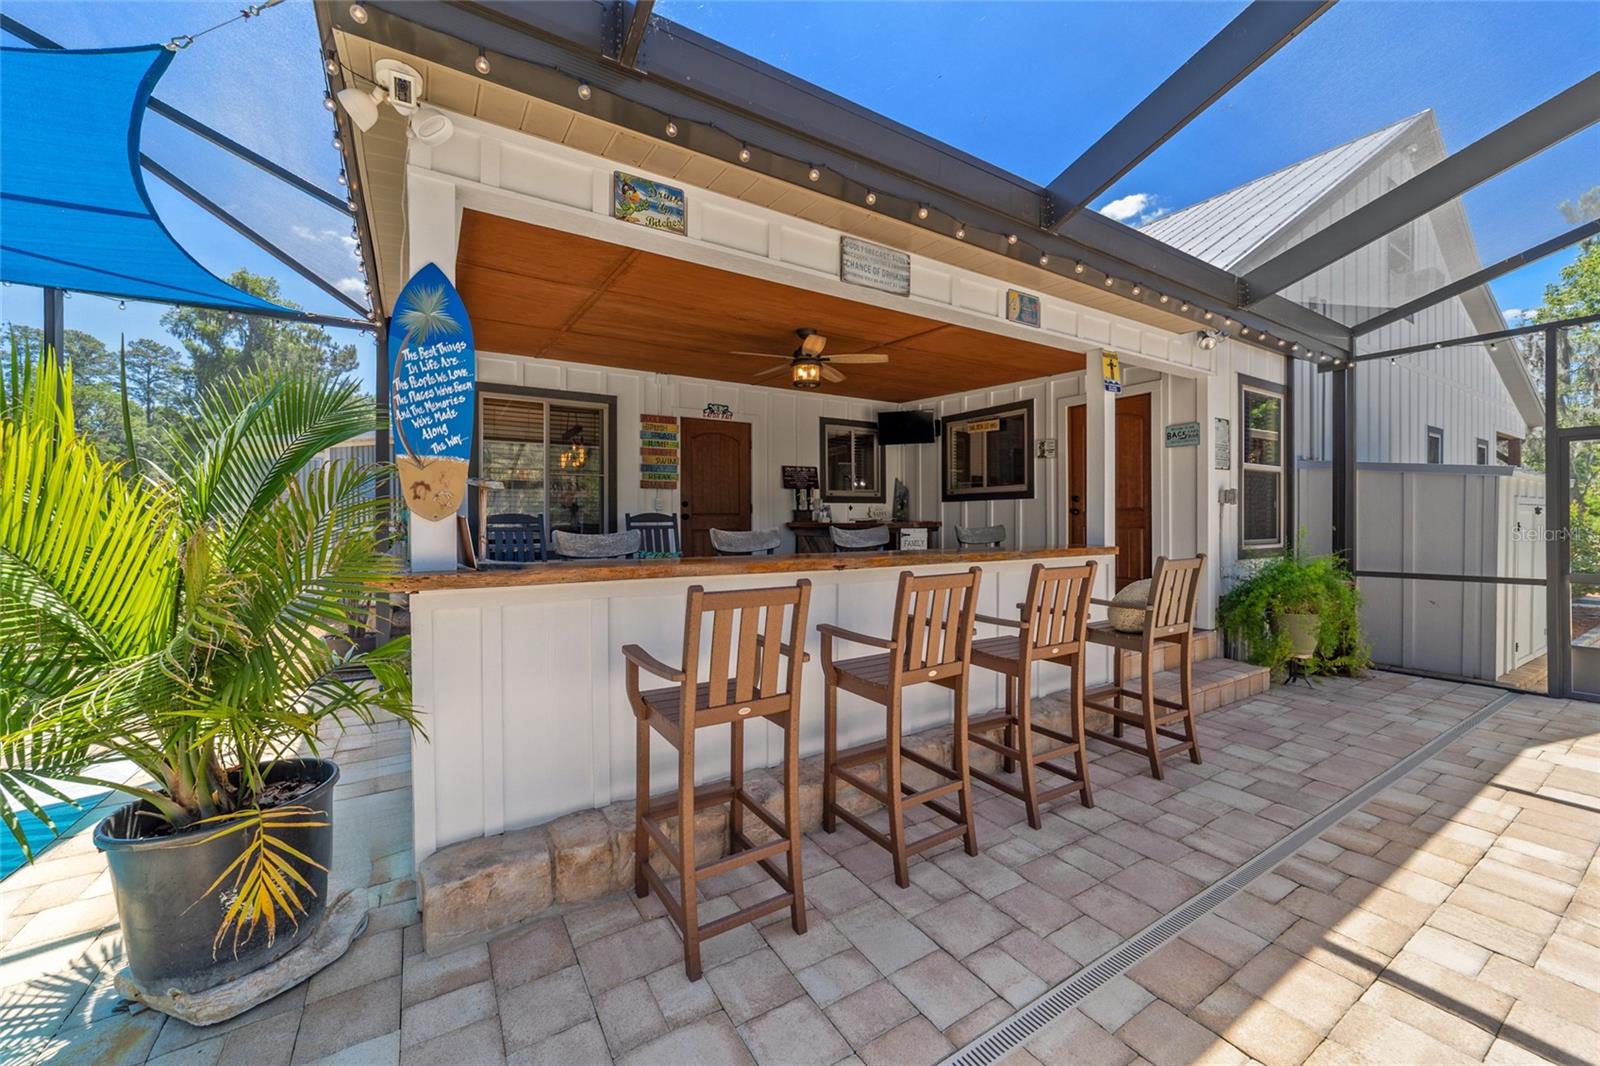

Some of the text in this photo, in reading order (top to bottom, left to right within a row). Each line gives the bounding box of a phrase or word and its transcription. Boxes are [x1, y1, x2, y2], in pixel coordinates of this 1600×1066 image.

[845, 259, 871, 274] CHANCE
[872, 266, 880, 276] OF
[402, 340, 467, 361] The Best Things
[405, 363, 419, 375] In
[420, 359, 440, 372] Life
[393, 377, 409, 391] The
[409, 373, 436, 389] People
[393, 394, 409, 406] The
[409, 390, 435, 403] Places
[453, 381, 473, 392] Been
[395, 395, 466, 420] And The Memories
[433, 407, 458, 422] Made
[422, 423, 448, 440] Along
[430, 441, 447, 454] The
[904, 540, 925, 548] FAMILY
